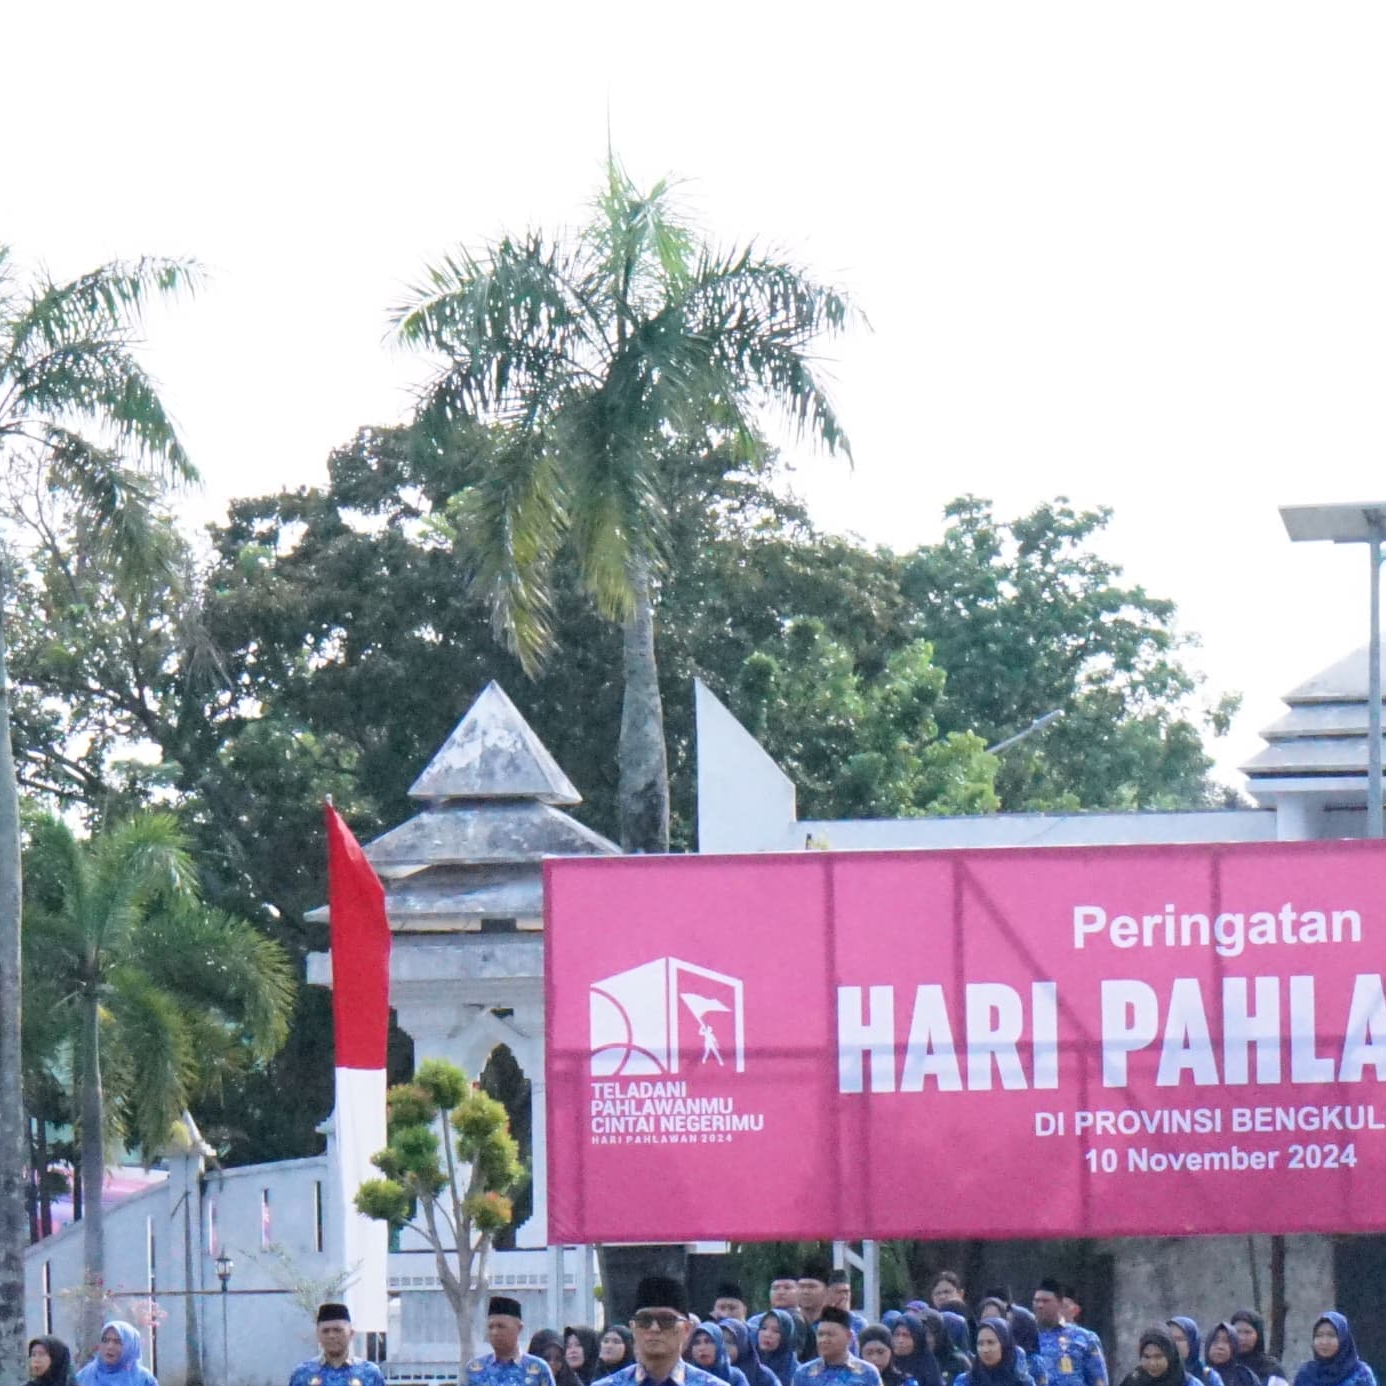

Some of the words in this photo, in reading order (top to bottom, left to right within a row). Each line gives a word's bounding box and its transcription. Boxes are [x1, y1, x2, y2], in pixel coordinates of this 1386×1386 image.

[1073, 902, 1362, 957] Peringatan
[837, 981, 1059, 1093] HARI
[591, 1081, 687, 1099] TELADANI
[591, 1098, 733, 1117] PAHLAWANMU
[591, 1115, 655, 1133] CINTAI
[660, 1113, 764, 1132] NEGERIMU
[1035, 1111, 1065, 1137] DI
[1074, 1108, 1222, 1136] PROVINSI
[591, 1134, 622, 1145] HARI
[626, 1134, 698, 1144] PAHLAWAN
[701, 1132, 733, 1143] 2024
[1085, 1148, 1118, 1173] 10
[1127, 1146, 1280, 1172] November
[1288, 1143, 1358, 1169] 2024
